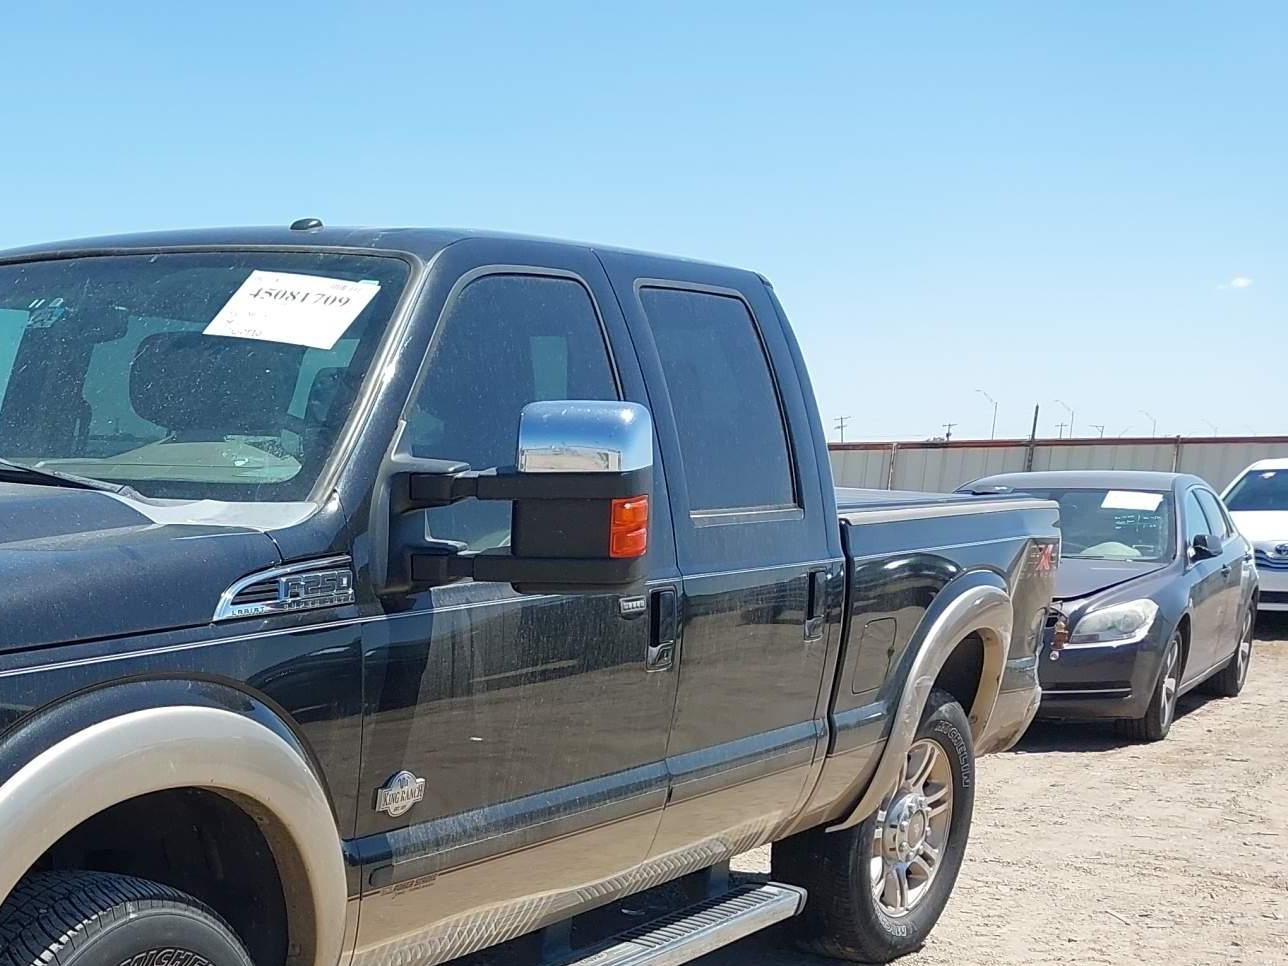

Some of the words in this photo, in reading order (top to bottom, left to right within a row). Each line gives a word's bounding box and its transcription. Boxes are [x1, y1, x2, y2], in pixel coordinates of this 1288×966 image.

[249, 287, 352, 307] 45081709
[934, 720, 971, 788] MICHELIN
[383, 791, 400, 806] KING
[400, 784, 424, 802] RANCH
